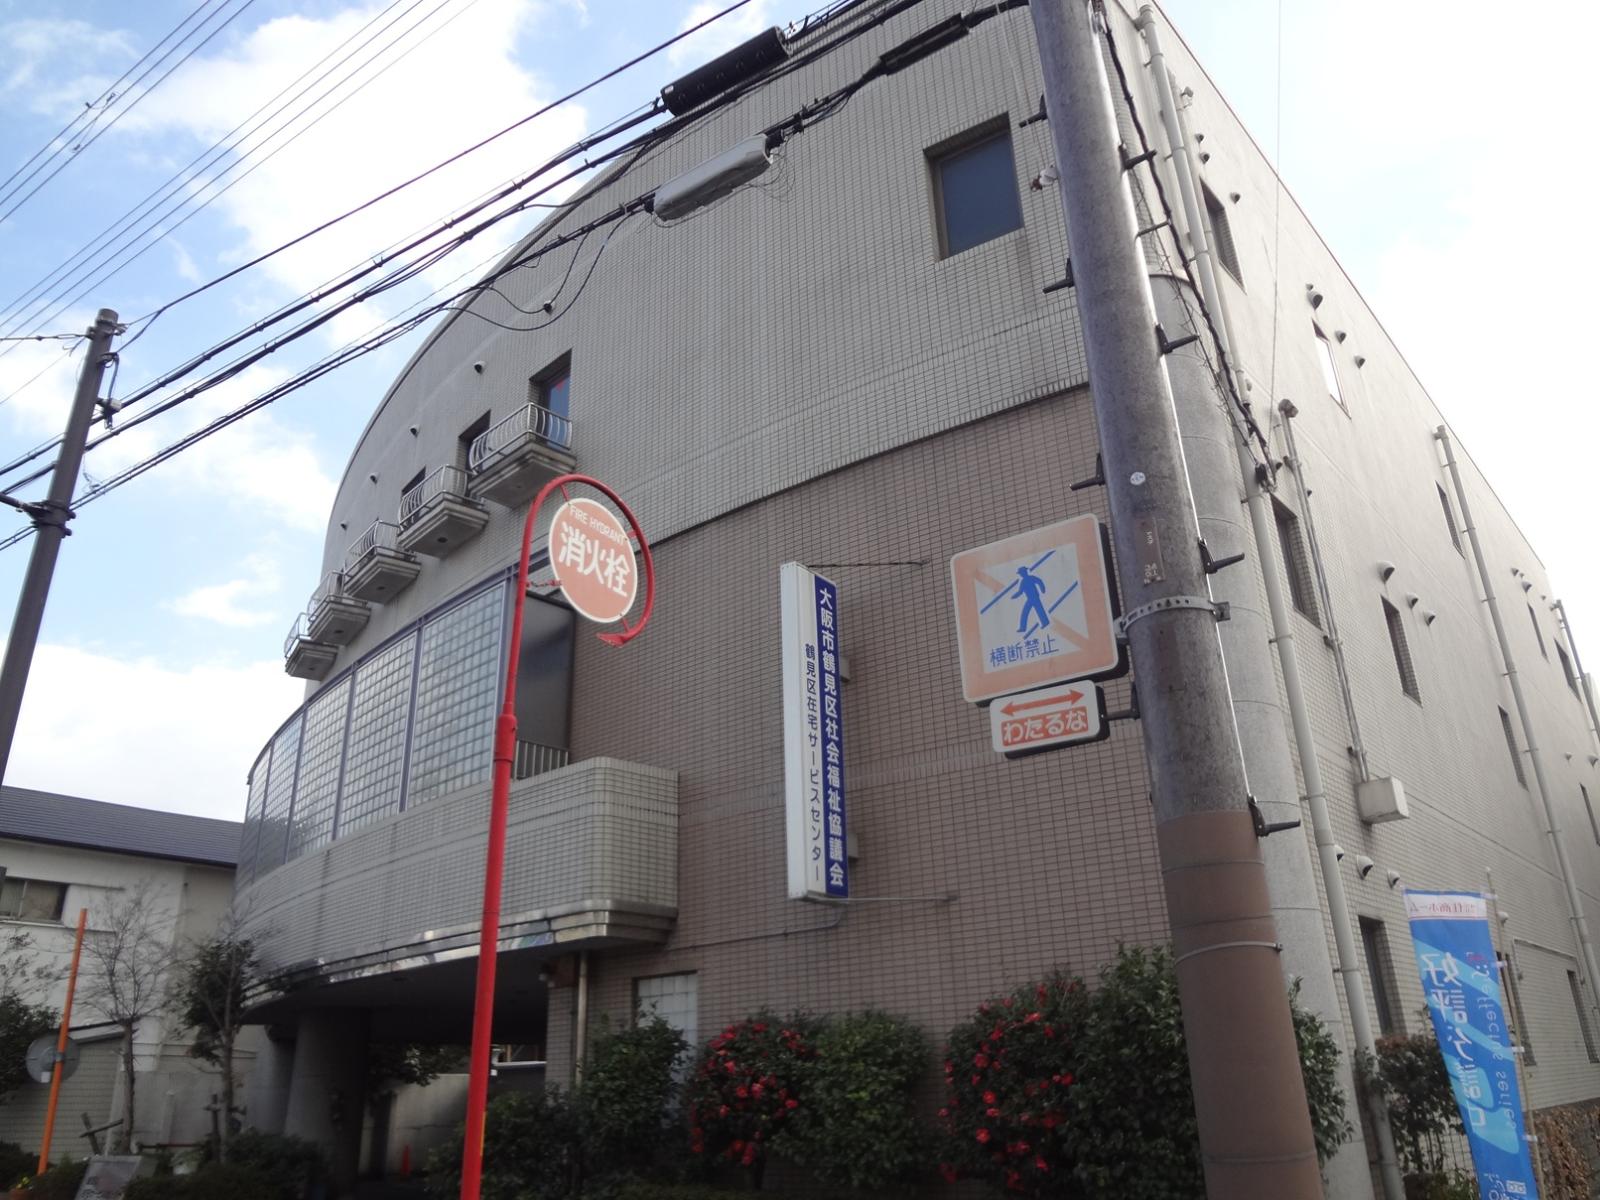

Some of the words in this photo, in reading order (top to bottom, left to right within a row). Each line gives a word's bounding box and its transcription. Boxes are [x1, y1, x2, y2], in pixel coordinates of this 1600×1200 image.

[570, 504, 588, 524] FIRE
[590, 517, 626, 545] HYDRANT
[559, 521, 630, 597] 消火栓
[989, 635, 1059, 667] 横断禁止
[820, 587, 844, 887] 大阪市鶴見区社会福祉協議会
[1003, 710, 1087, 742] わたるな
[805, 643, 821, 881] 鶴見区在宅サービスセンター
